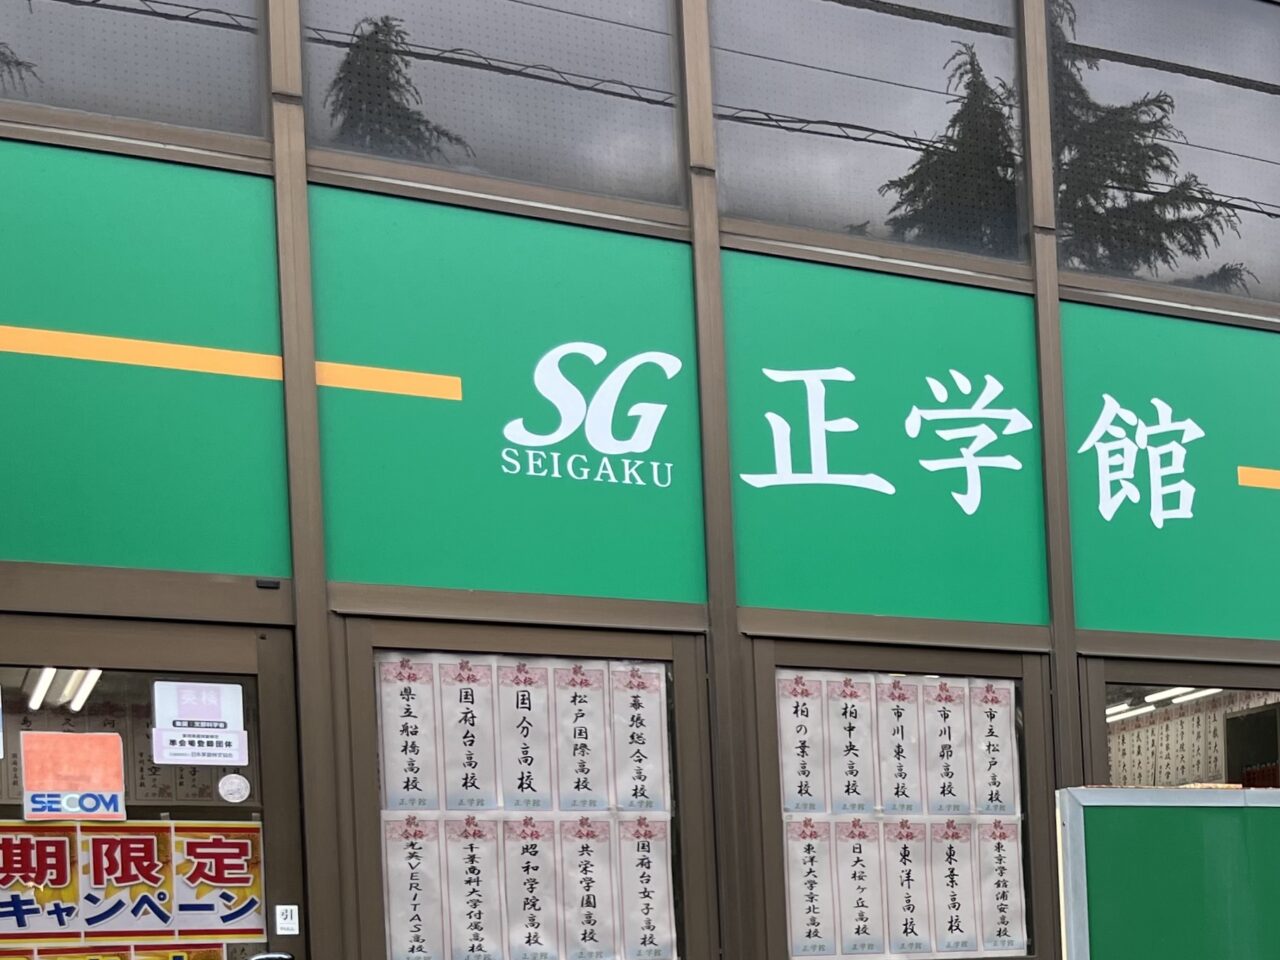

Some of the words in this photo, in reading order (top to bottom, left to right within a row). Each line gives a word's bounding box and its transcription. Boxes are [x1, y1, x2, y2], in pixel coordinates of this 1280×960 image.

[502, 341, 682, 455] SG
[501, 448, 674, 488] SEIGAKU
[740, 367, 1205, 529] 正学館
[400, 687, 422, 792] 県立船橋高校
[458, 688, 480, 790] 国府台高校
[515, 690, 537, 792] 国分高校
[570, 692, 592, 791] 松戸国際高校
[628, 695, 649, 799] 幕張総合高校
[793, 702, 813, 797] 柏の葉高校
[842, 703, 861, 795] 柏中央高校
[891, 705, 910, 798] 市川東高校
[937, 707, 956, 797] 市川昴高校
[984, 708, 1002, 804] 市立松戸高校
[31, 793, 119, 812] SECOM
[0, 837, 252, 886] 期限定
[0, 891, 259, 927] キャンペーン
[404, 840, 428, 954] 光英VERITAS高校
[463, 844, 486, 953] 千葉商科大学付属高校
[521, 844, 544, 946] 昭和学院高校
[578, 845, 599, 943] 共栄学園高校
[636, 840, 658, 947] 国府台女子高校
[803, 844, 823, 939] 東洋大学京北高校
[899, 844, 919, 936] 東洋高校
[944, 844, 964, 934] 東葉高校
[994, 842, 1011, 938] 東京学館浦安高校
